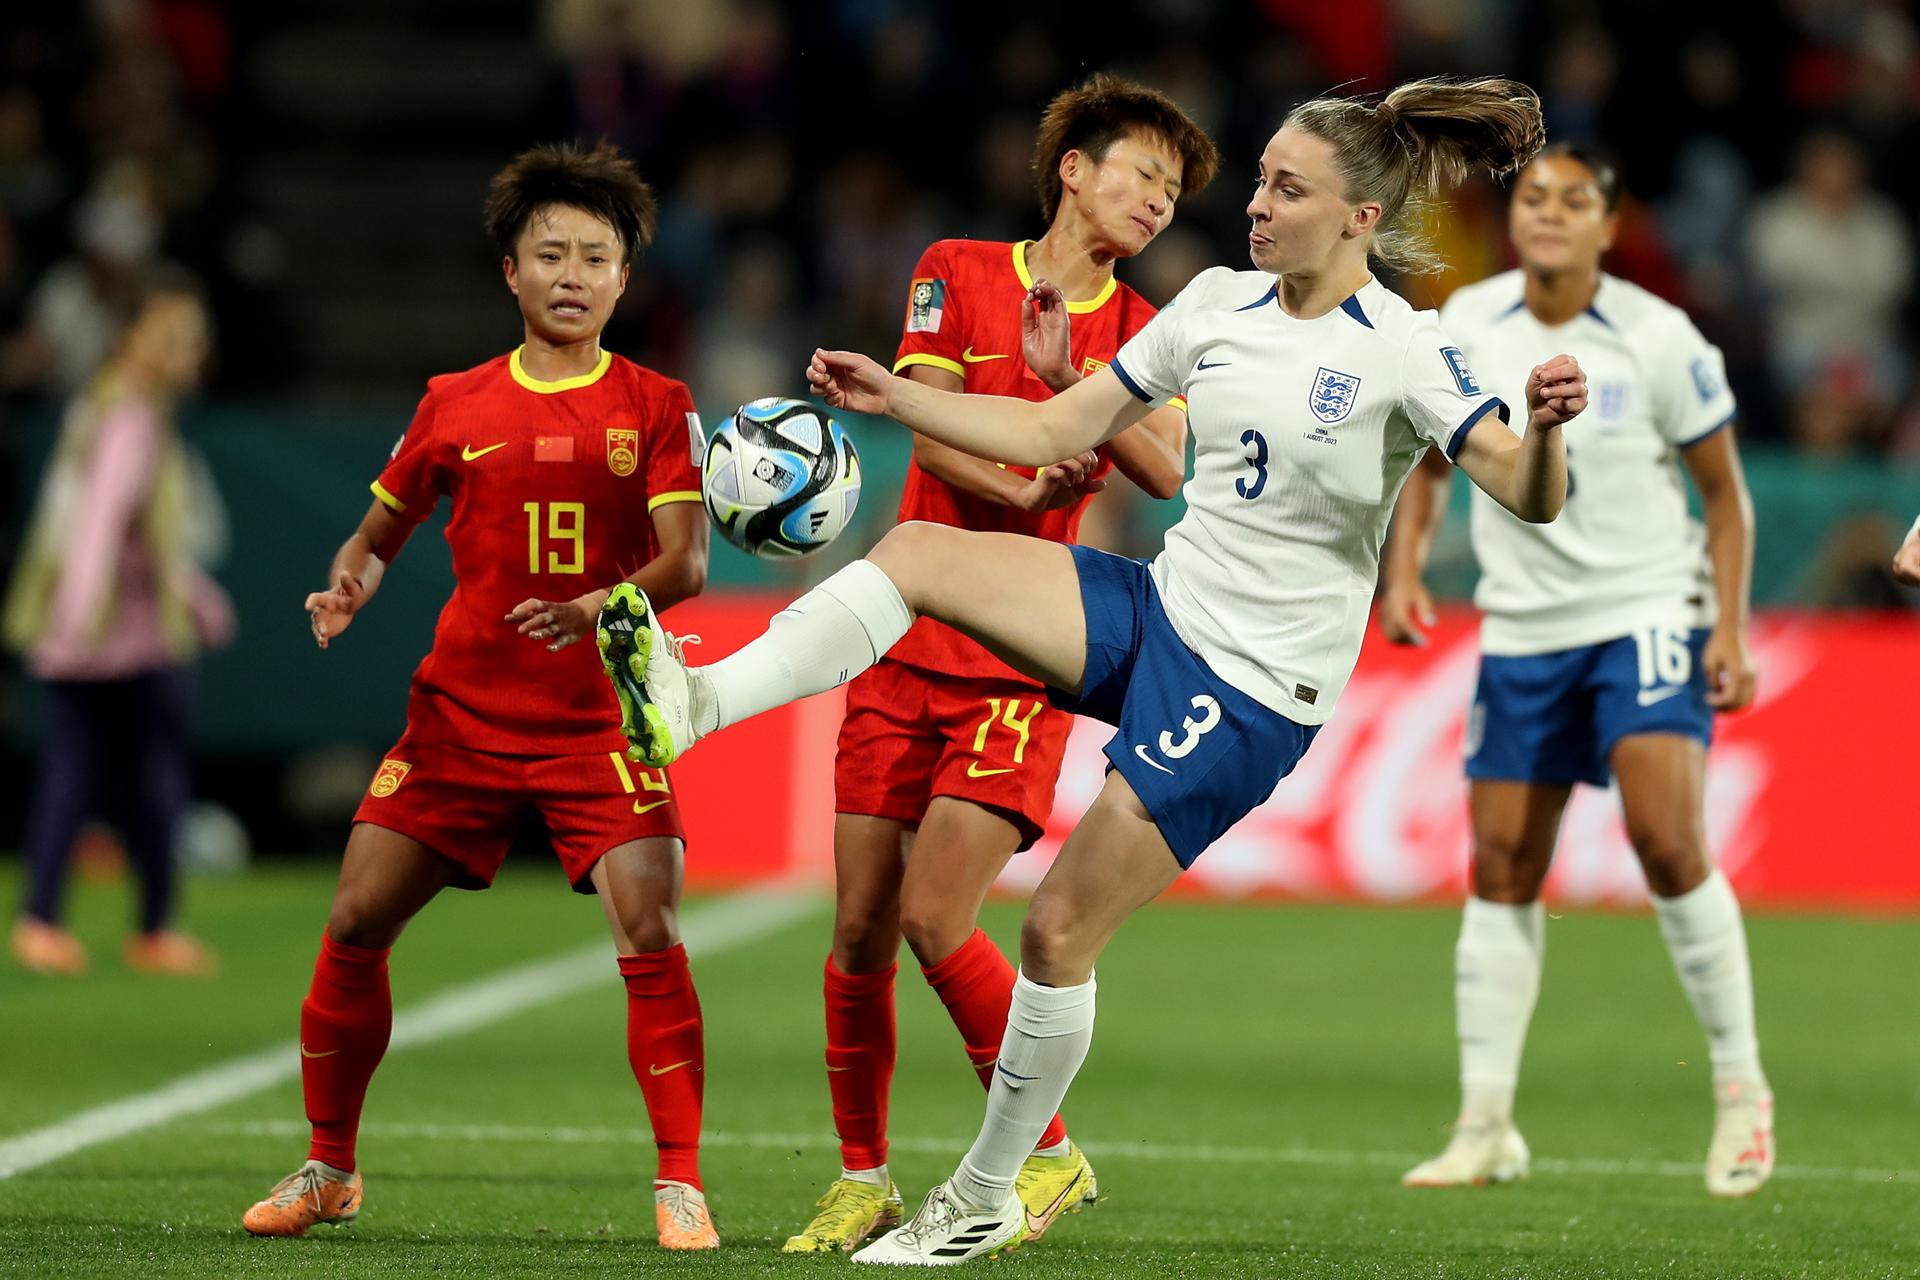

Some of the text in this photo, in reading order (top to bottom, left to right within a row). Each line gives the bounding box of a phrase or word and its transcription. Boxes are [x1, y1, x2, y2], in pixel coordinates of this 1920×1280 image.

[610, 431, 635, 442] CFA
[1306, 433, 1324, 442] AUGUST
[1324, 437, 1338, 445] 2023
[1315, 427, 1328, 436] CHINA
[1235, 429, 1268, 500] 3
[523, 502, 585, 574] 19
[1632, 625, 1692, 686] 16
[973, 698, 1043, 764] 14
[1159, 694, 1221, 759] 3
